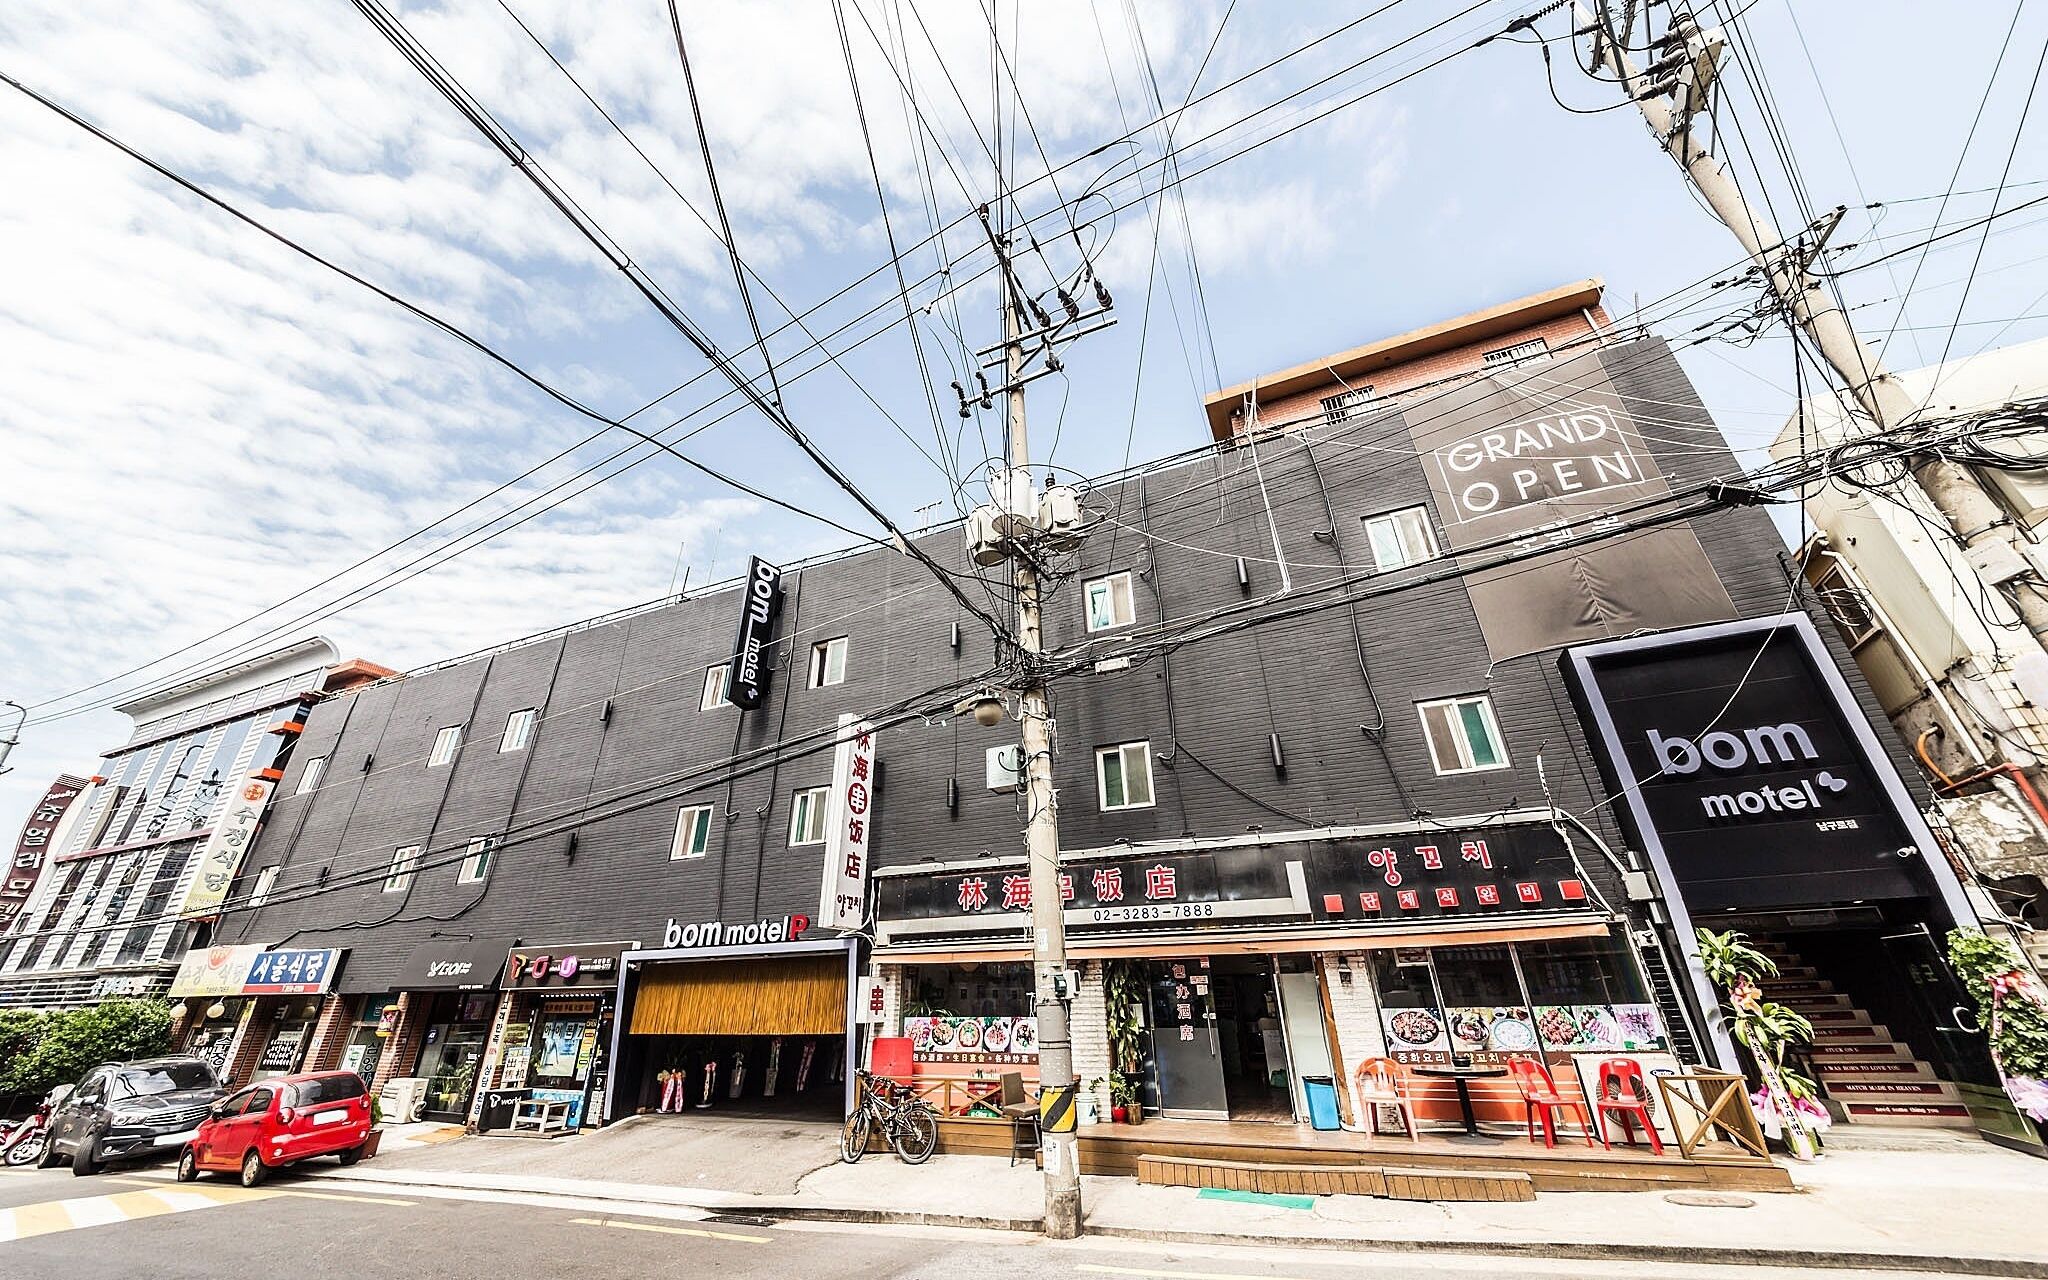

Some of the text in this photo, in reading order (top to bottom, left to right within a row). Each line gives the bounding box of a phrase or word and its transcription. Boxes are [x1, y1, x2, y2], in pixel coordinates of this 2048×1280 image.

[1447, 414, 1608, 473] GRAND
[1462, 451, 1633, 513] OPEN
[743, 561, 780, 685] bom motel
[1646, 722, 1819, 776] bom
[1701, 780, 1822, 818] motel
[205, 806, 257, 892] 수정식당
[1368, 840, 1493, 886] 양꼬치
[837, 894, 863, 918] 양꼬치
[1094, 904, 1213, 922] 02-3283-7888
[664, 919, 723, 949] bom
[253, 952, 324, 983] 서울식당
[870, 985, 884, 1015] 串
[1172, 964, 1194, 1041] 包办酒席
[1397, 1053, 1446, 1064] 중화요리
